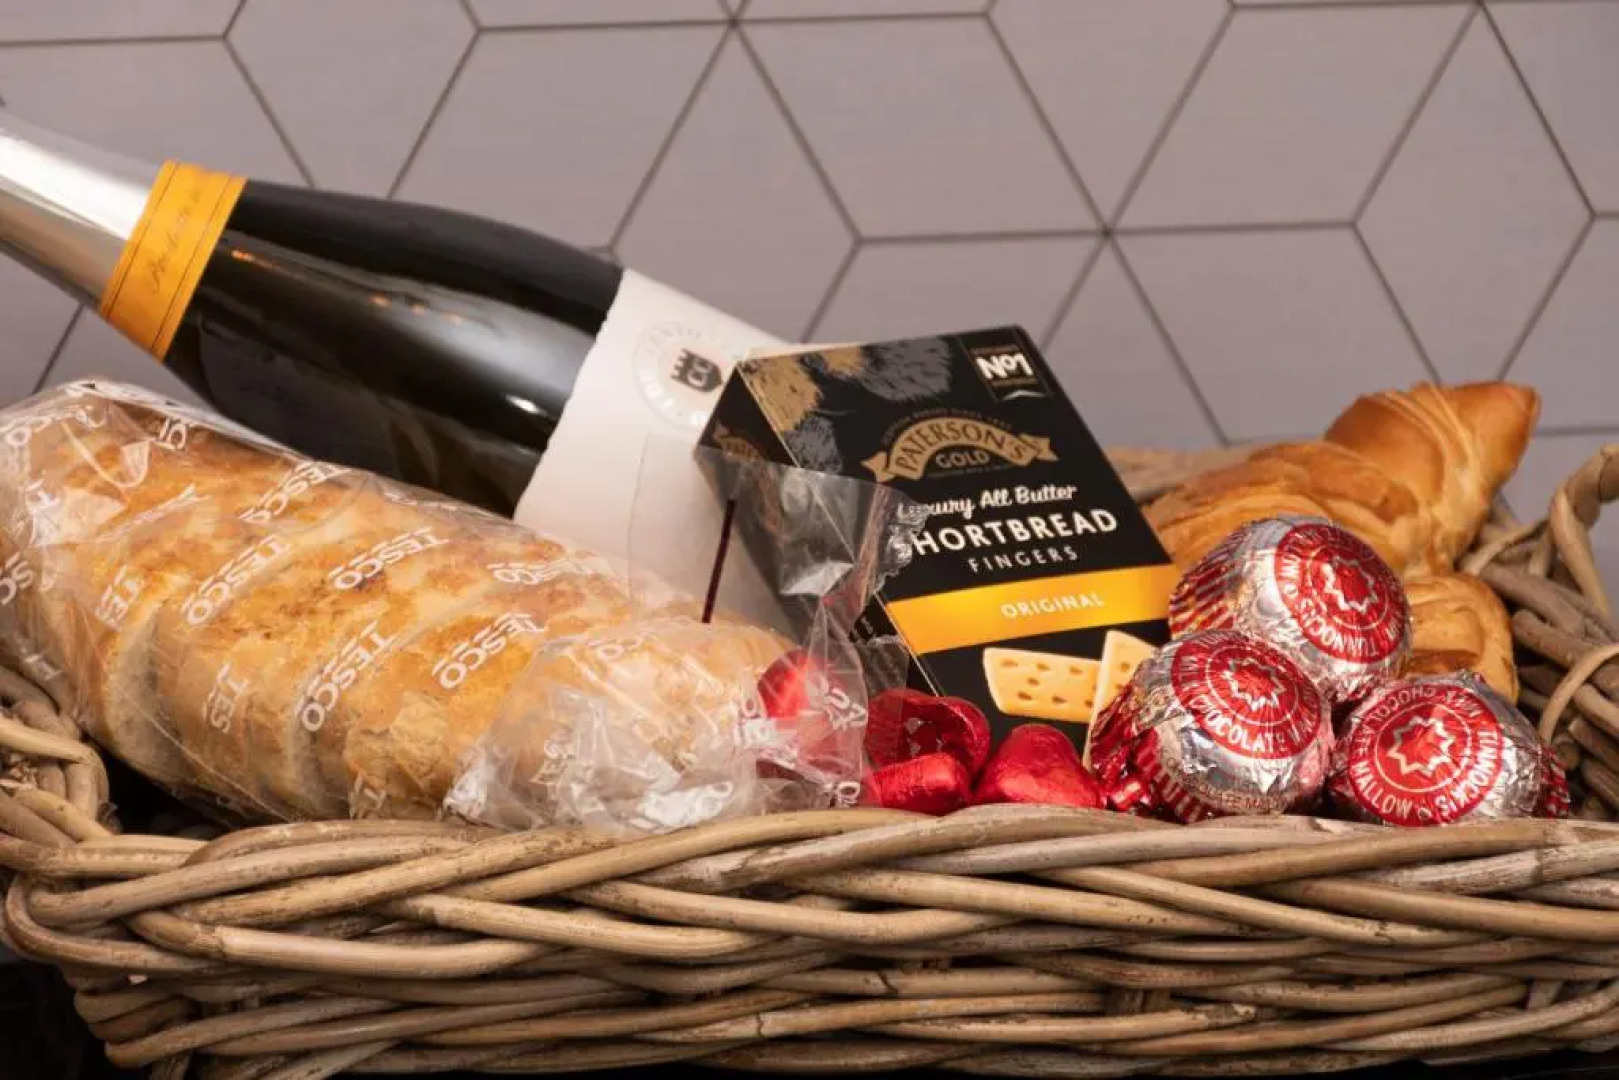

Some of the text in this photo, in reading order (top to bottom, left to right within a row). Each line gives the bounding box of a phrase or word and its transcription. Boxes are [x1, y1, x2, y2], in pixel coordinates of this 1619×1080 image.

[895, 420, 1026, 472] PATERSON'S
[934, 450, 991, 469] GOLD
[979, 489, 1013, 510] All
[1015, 483, 1079, 505] Butter
[332, 528, 449, 591] TESCO
[892, 508, 1118, 560] SHORTBREAD
[967, 545, 1079, 574] FINGERS
[181, 533, 290, 625] TESCO
[1000, 591, 1106, 619] ORIGINAL
[295, 621, 400, 732] TESCO
[432, 611, 548, 690] TESCO
[1356, 685, 1437, 758] CHOCOLATE
[1351, 760, 1414, 820] MALLOW
